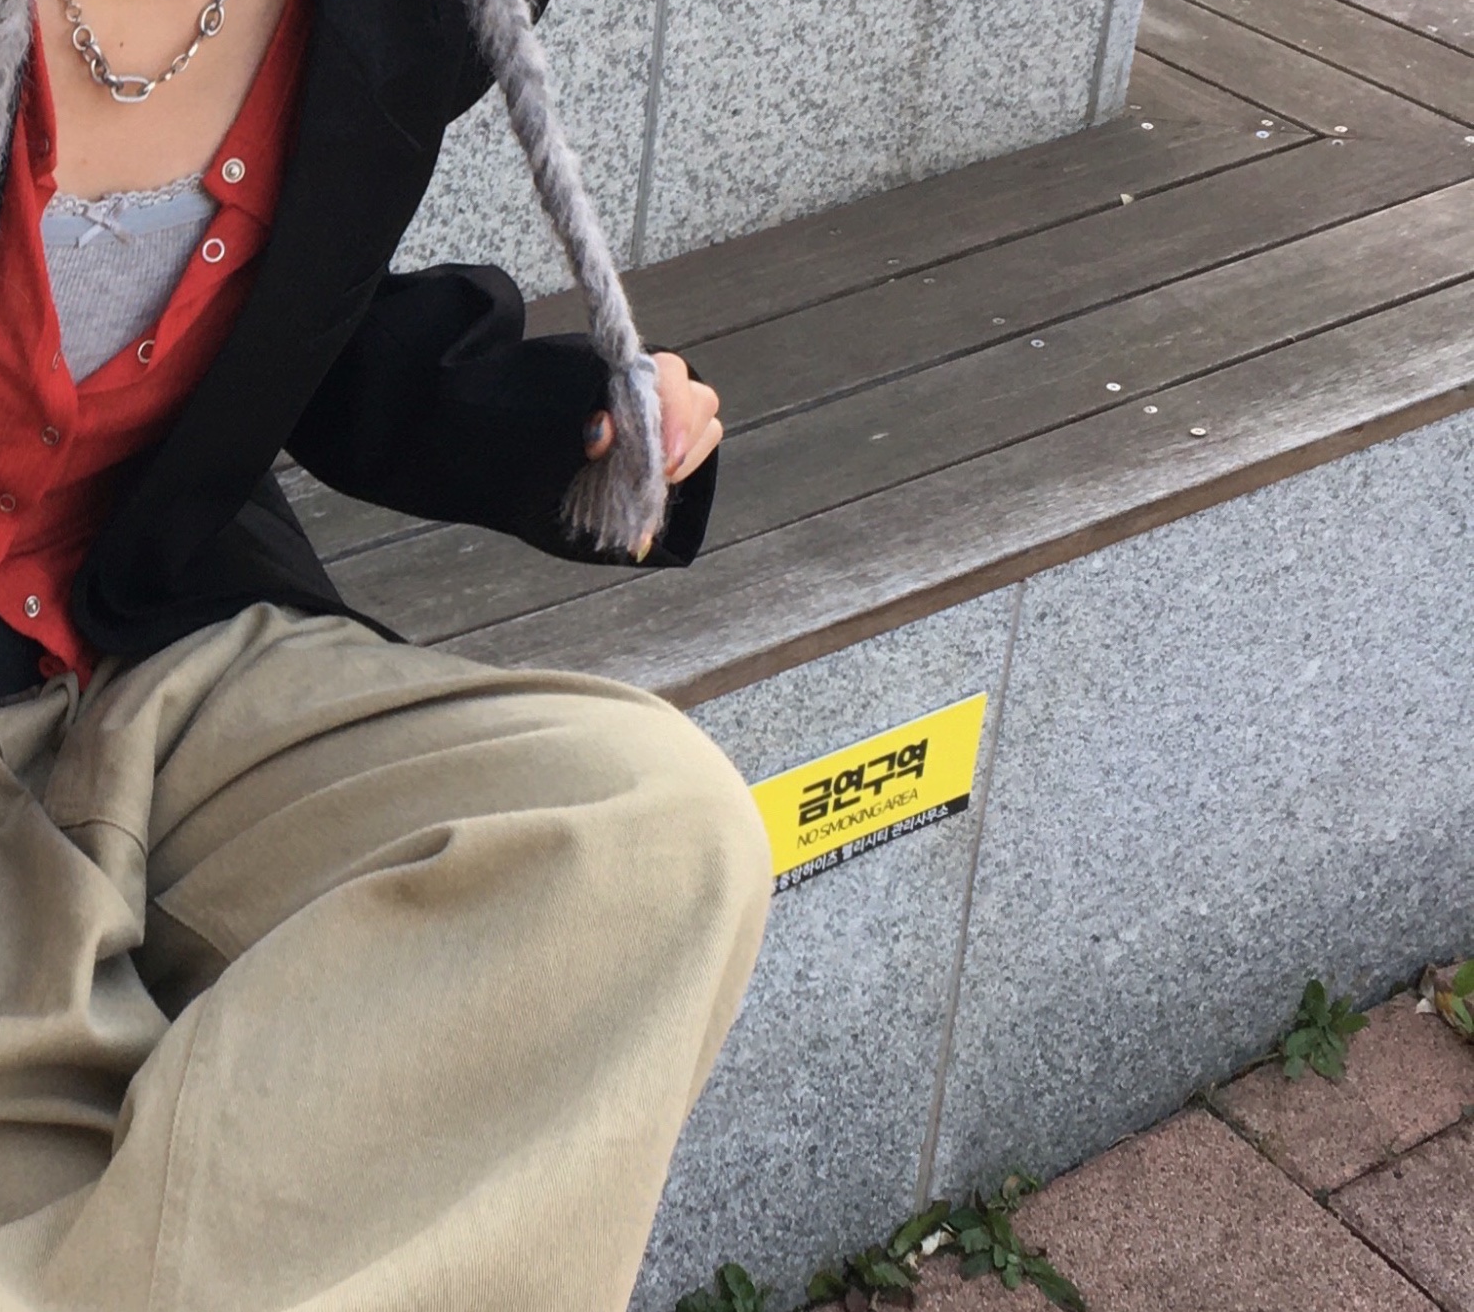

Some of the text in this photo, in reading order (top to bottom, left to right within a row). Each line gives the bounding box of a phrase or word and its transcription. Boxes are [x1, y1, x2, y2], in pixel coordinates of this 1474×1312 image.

[797, 738, 929, 827] 금연구역
[797, 787, 919, 849] NO SMOKING AREA
[891, 803, 949, 838] 관리사무소
